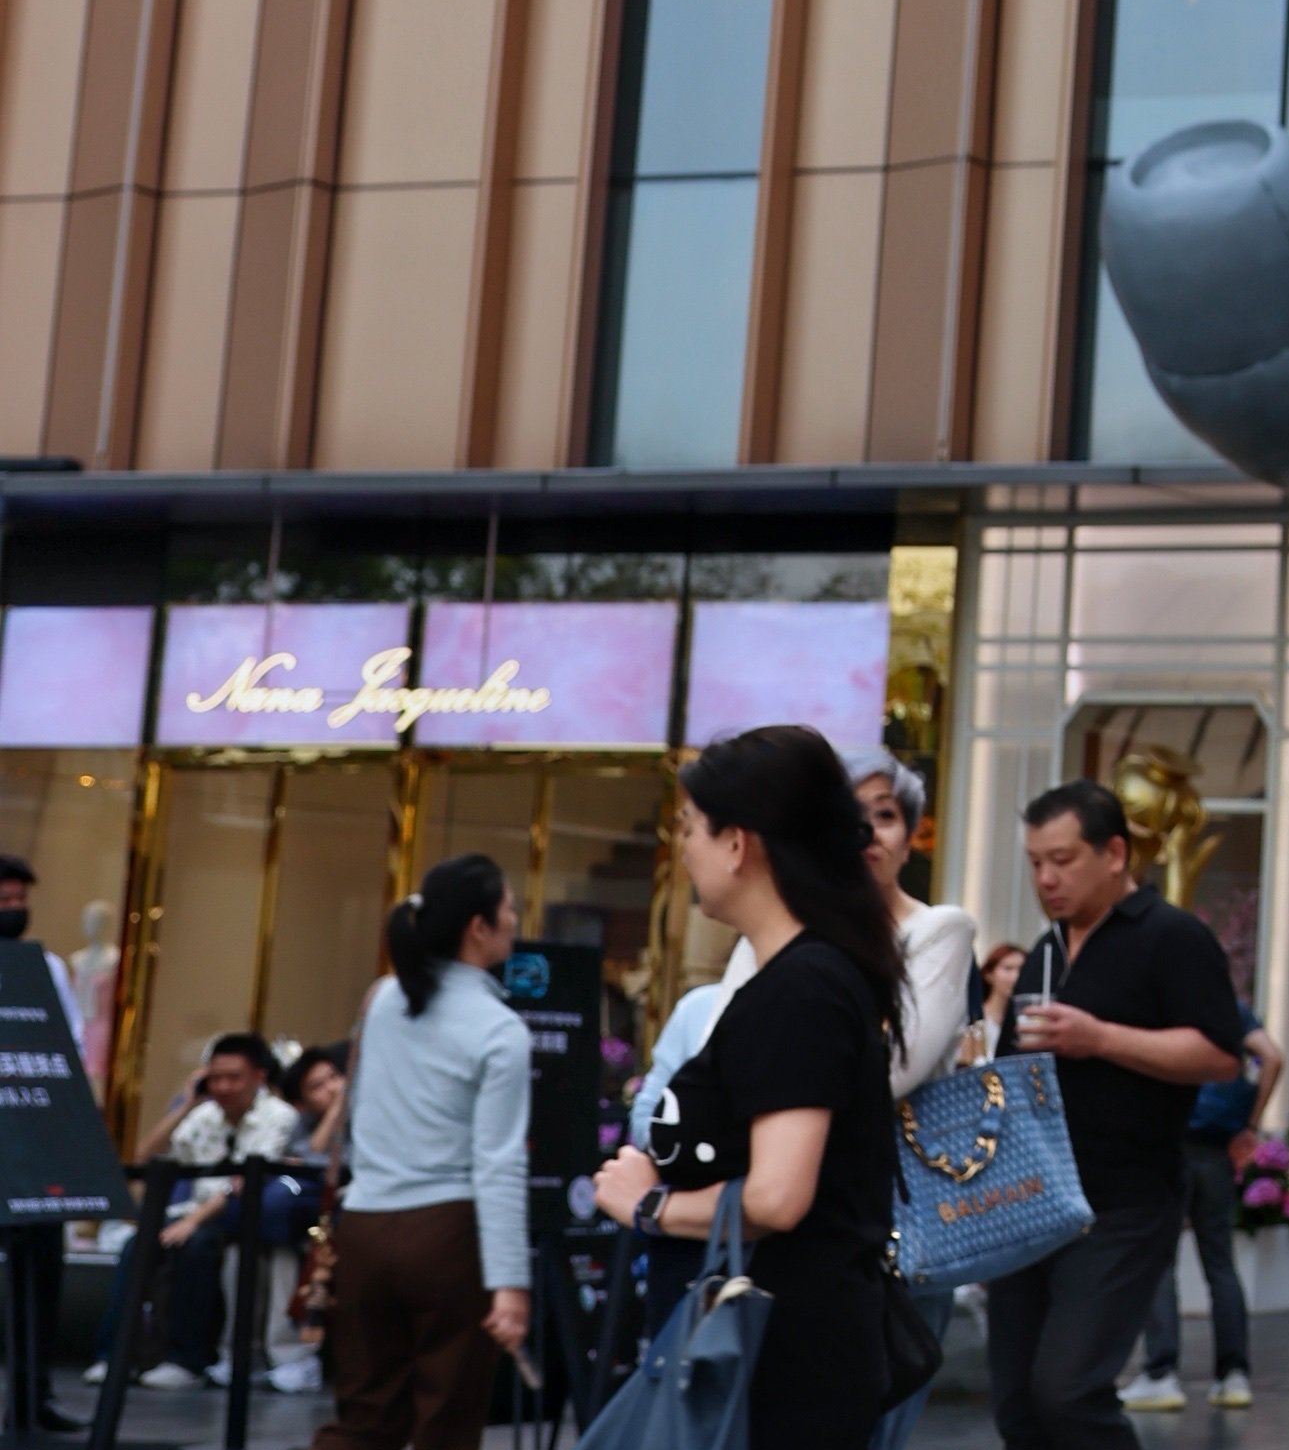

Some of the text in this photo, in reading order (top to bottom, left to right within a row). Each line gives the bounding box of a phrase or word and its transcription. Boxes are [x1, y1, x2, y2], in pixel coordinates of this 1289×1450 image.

[186, 646, 552, 733] Nana Jacqueline
[937, 1175, 1045, 1226] BALMAIN
